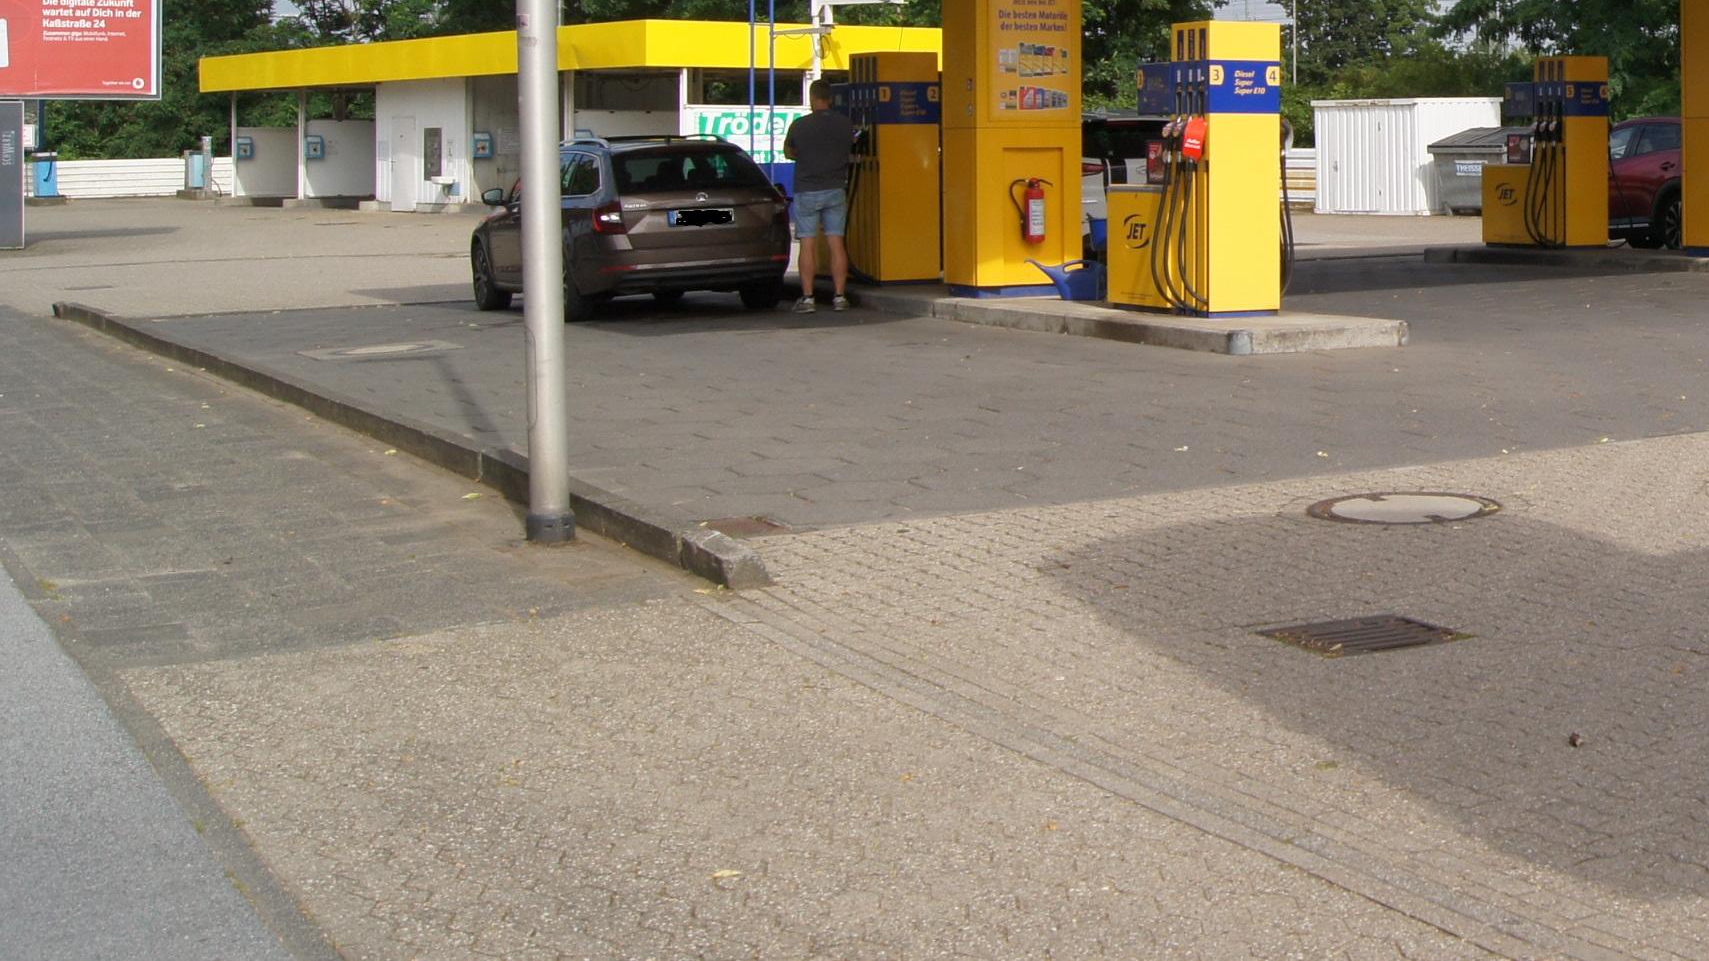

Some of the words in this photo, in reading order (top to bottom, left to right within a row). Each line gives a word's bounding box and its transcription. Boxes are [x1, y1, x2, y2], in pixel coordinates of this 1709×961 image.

[42, 8, 73, 17] wartet
[75, 8, 91, 17] auf
[92, 8, 113, 17] Dich
[115, 9, 124, 17] in
[126, 9, 142, 18] der
[42, 18, 92, 28] Kaßstraße
[93, 19, 106, 28] 24
[1213, 69, 1219, 81] 3
[1269, 70, 1276, 82] 4
[702, 111, 795, 136] Trödel
[1126, 223, 1147, 240] JET
